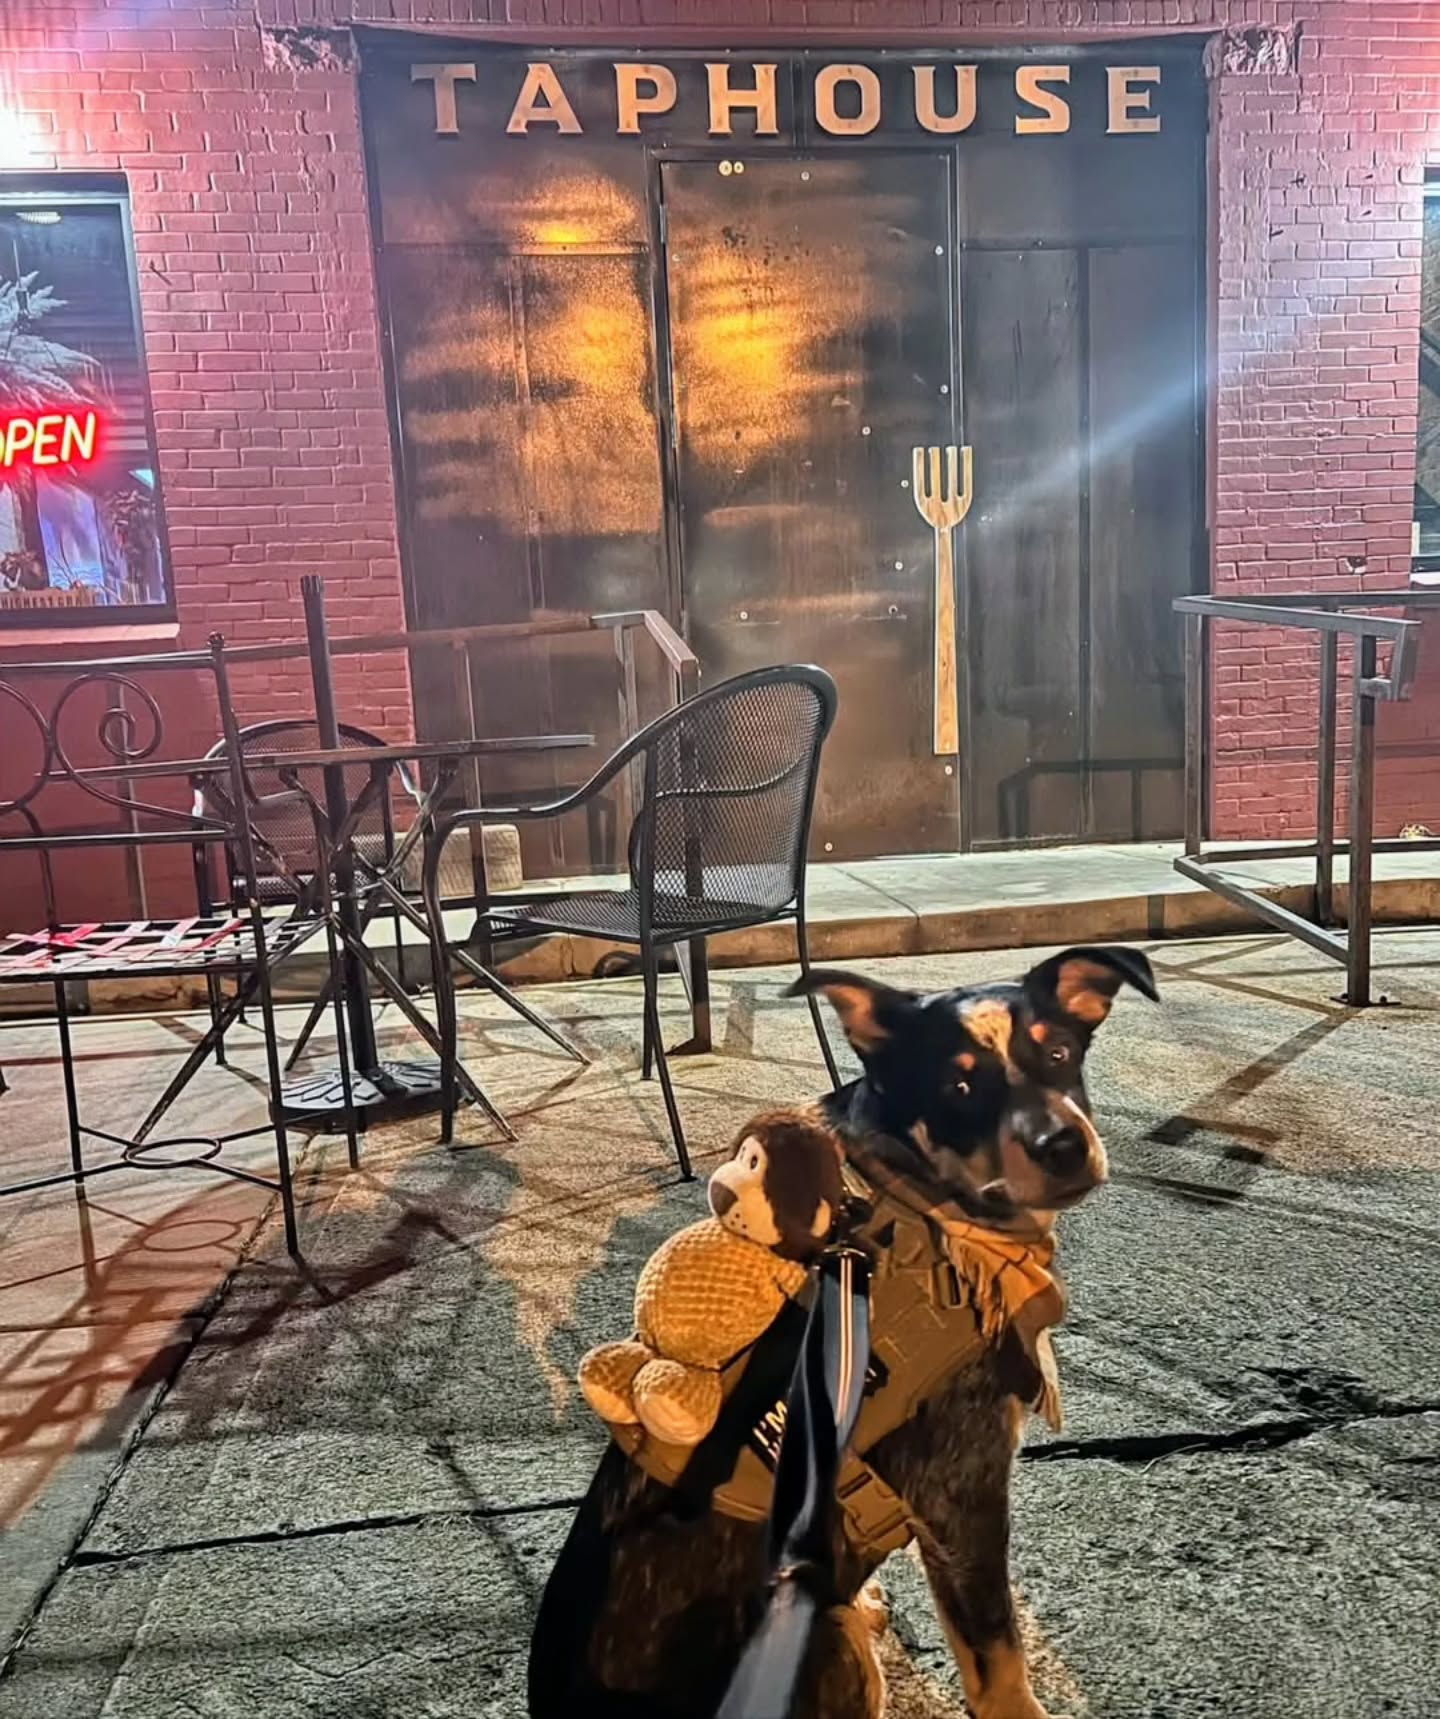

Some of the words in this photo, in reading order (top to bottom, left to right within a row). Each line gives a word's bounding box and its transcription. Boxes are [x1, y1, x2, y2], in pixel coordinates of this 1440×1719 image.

[411, 63, 1162, 135] TAPHOUSE
[0, 412, 95, 467] PEN
[752, 1400, 787, 1447] I'M
